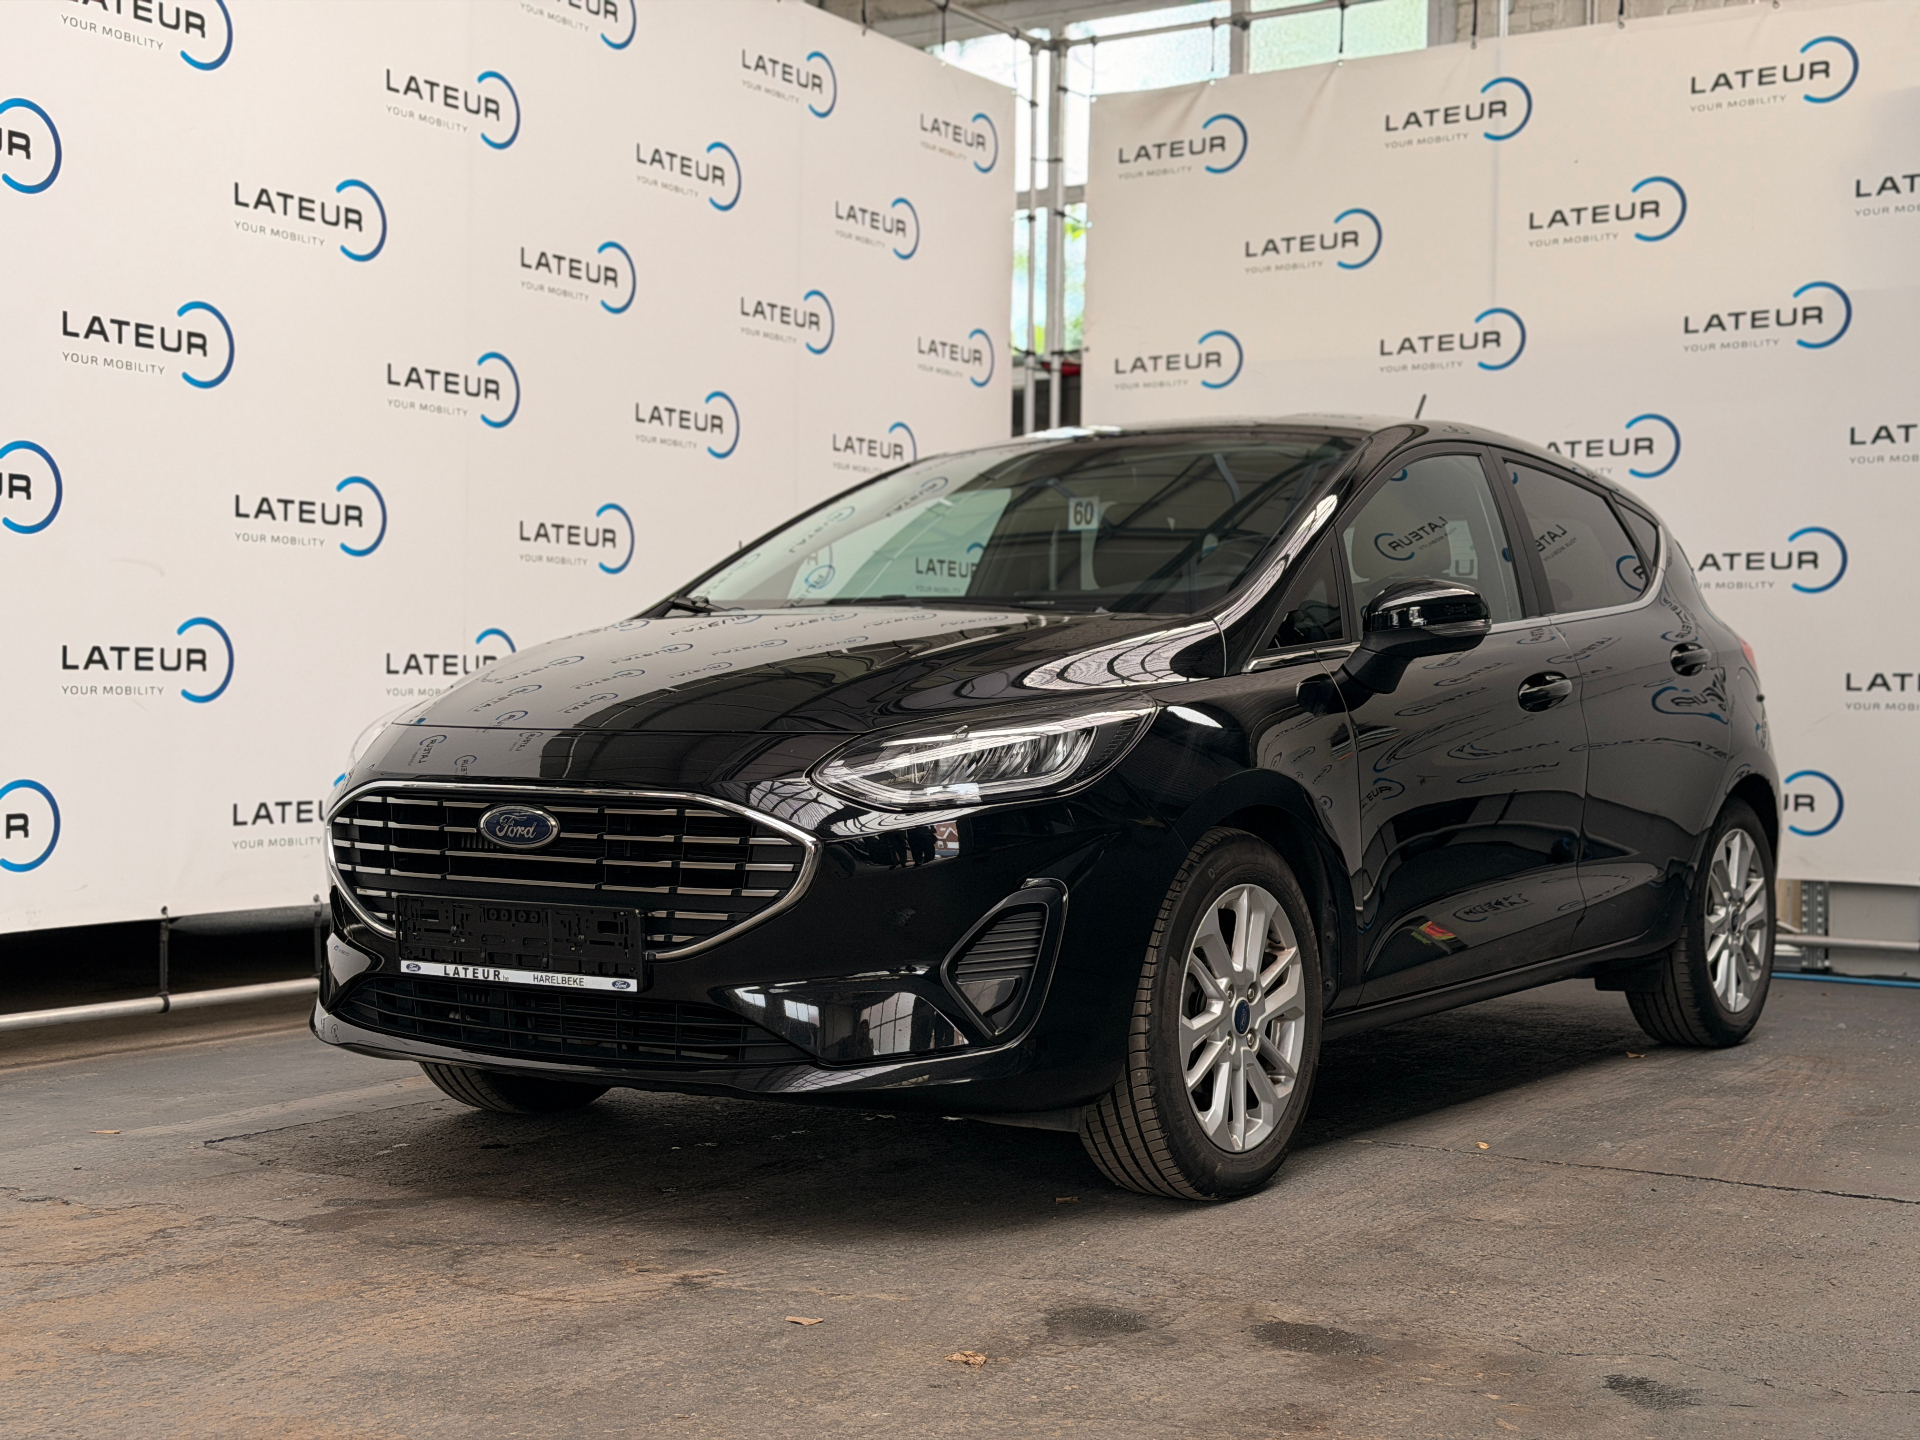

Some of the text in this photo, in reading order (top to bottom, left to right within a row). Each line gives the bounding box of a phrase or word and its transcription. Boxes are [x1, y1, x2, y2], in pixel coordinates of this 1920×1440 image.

[519, 2, 590, 32] YOUR MOBILITY
[60, 14, 163, 50] YOUR MOBILITY
[741, 49, 823, 94] LATEUR
[1690, 60, 1831, 95] LATEUR
[386, 68, 500, 122] LATEUR
[1690, 94, 1787, 113] YOUR MOBILITY
[386, 104, 469, 134] YOUR MOBILITY
[1385, 99, 1507, 132] LATEUR
[920, 114, 986, 151] LATEUR
[1384, 132, 1469, 149] YOUR MOBILITY
[1118, 135, 1226, 164] LATEUR
[636, 143, 725, 187] LATEUR
[1118, 165, 1192, 180] YOUR MOBILITY
[234, 181, 363, 233] LATEUR
[835, 201, 907, 237] LATEUR
[1529, 199, 1660, 230] LATEUR
[1854, 206, 1890, 217] YOUR
[234, 220, 325, 247] YOUR MOBILITY
[1245, 230, 1359, 258] LATEUR
[1528, 232, 1619, 248] YOUR MOBILITY
[520, 246, 618, 288] LATEUR
[1244, 260, 1324, 274] YOUR MOBILITY
[520, 281, 590, 301] YOUR MOBILITY
[740, 297, 820, 331] LATEUR
[1683, 305, 1824, 335] LATEUR
[62, 310, 208, 358] LATEUR
[1379, 330, 1501, 357] LATEUR
[1683, 338, 1780, 353] YOUR MOBILITY
[61, 351, 165, 375] YOUR MOBILITY
[917, 337, 983, 366] LATEUR
[1114, 351, 1222, 375] LATEUR
[1379, 360, 1463, 373] YOUR MOBILITY
[387, 363, 500, 401] LATEUR
[1114, 379, 1188, 391] YOUR MOBILITY
[387, 399, 468, 417] YOUR MOBILITY
[635, 402, 724, 434] LATEUR
[832, 433, 904, 461] LATEUR
[1849, 454, 1885, 465] YOUR
[234, 494, 363, 528] LATEUR
[1073, 500, 1094, 526] 60
[234, 532, 325, 547] YOUR MOBILITY
[519, 520, 617, 549] LATEUR
[519, 553, 588, 566] YOUR MOBILITY
[1691, 550, 1819, 572] ATEUR
[1715, 580, 1775, 590] MOBILITY
[61, 644, 207, 672] LATEUR
[61, 685, 164, 696] YOUR MOBILITY
[385, 687, 414, 697] YOUR
[1845, 672, 1920, 692] LAT
[1844, 702, 1881, 711] YOUR
[496, 814, 538, 839] Ford
[232, 836, 323, 850] YOUR MOBILITY
[443, 965, 501, 981] LATEUR
[532, 973, 585, 987] HARELBEKE
